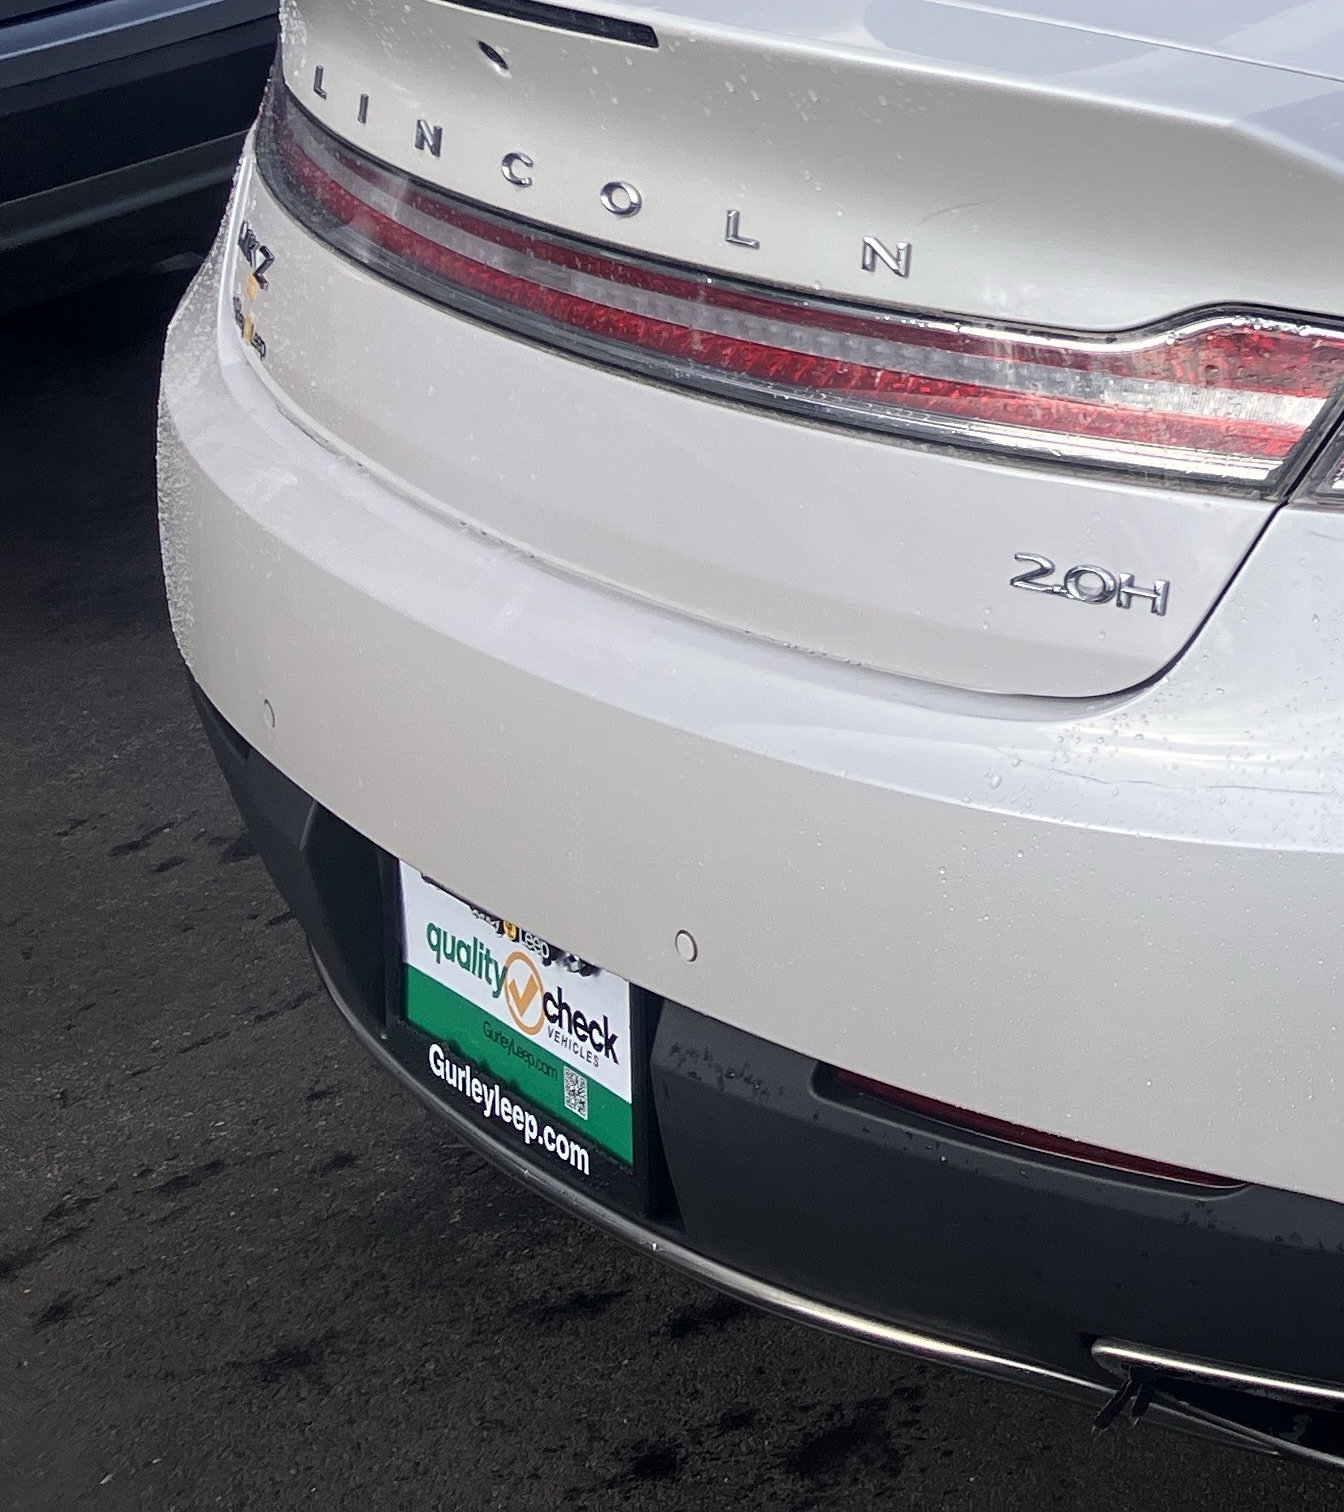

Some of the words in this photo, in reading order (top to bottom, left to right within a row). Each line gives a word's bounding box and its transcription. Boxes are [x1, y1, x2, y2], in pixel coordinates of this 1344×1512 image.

[312, 64, 914, 279] LINCOLN
[426, 922, 509, 999] quality
[542, 986, 620, 1065] check
[547, 1025, 600, 1068] VEHICLES
[428, 1043, 590, 1175] Gurleyleep.com
